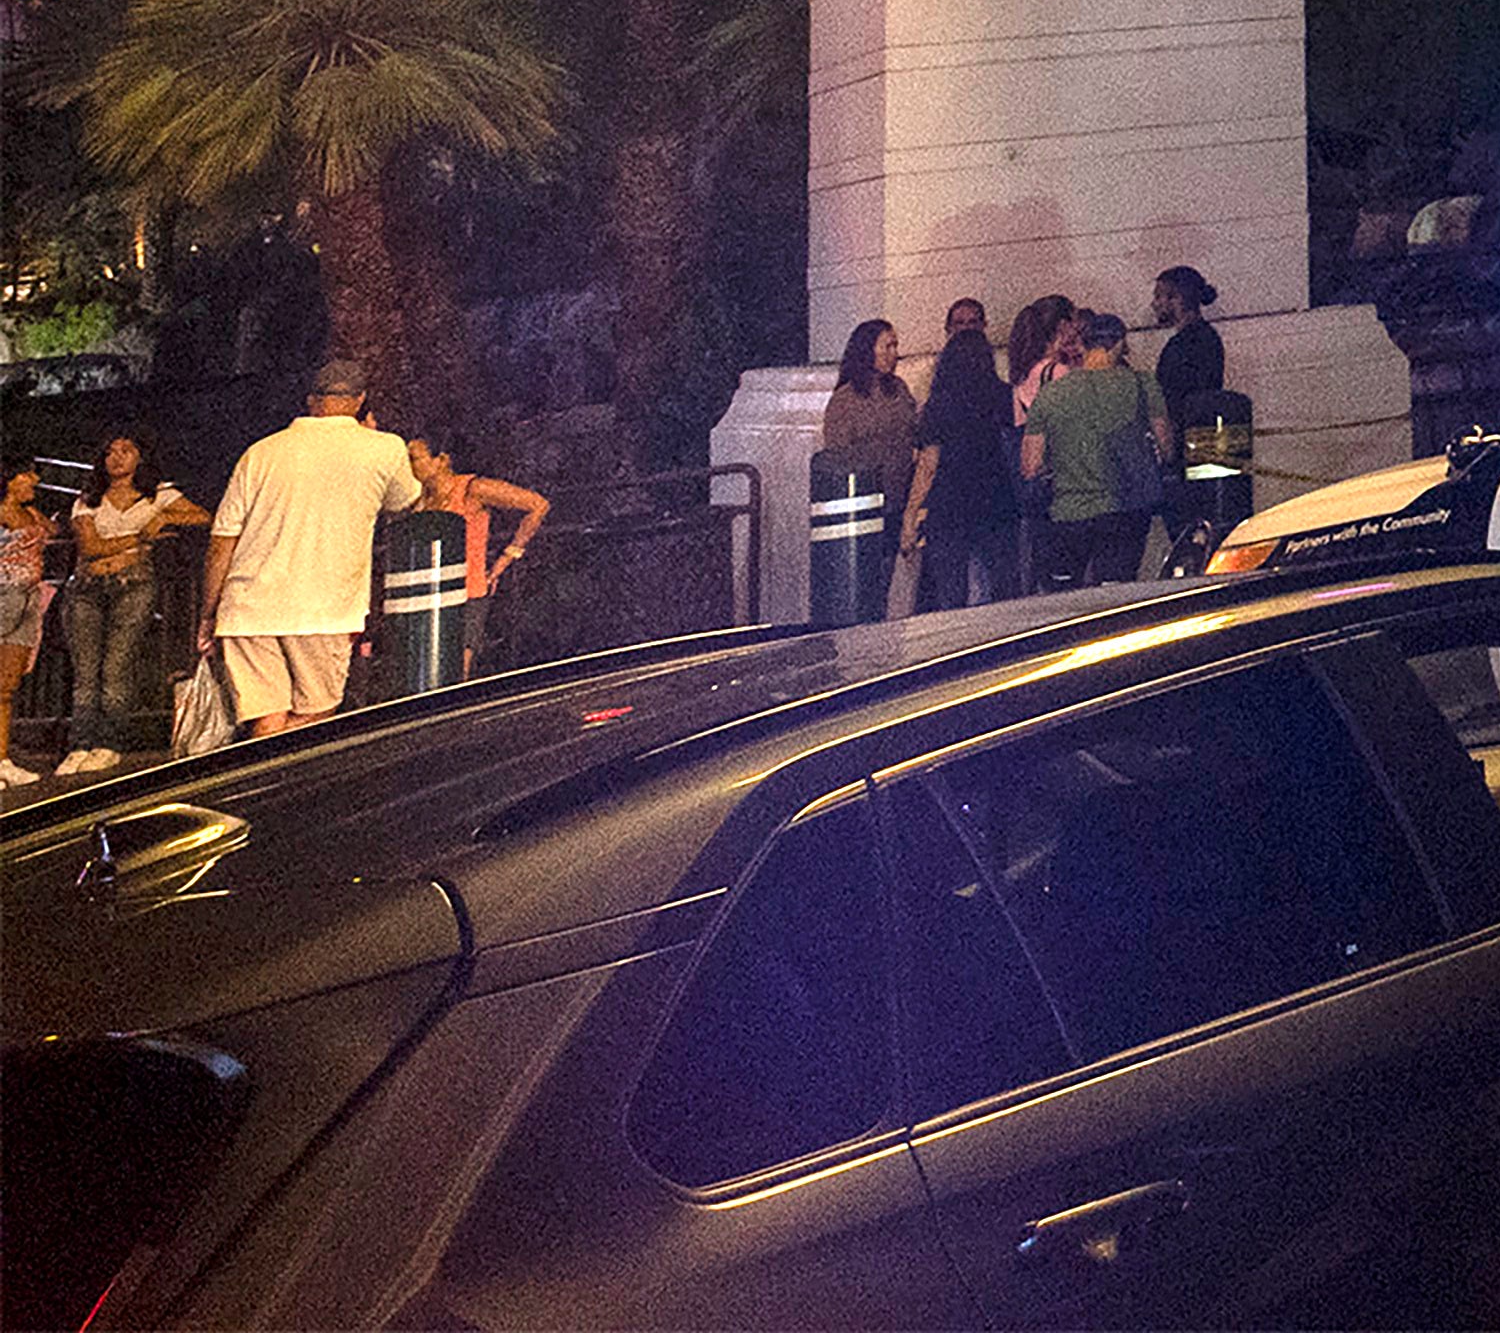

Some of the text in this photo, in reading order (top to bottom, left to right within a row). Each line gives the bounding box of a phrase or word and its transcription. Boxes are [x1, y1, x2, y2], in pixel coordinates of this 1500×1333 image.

[1333, 525, 1358, 542] with
[1359, 522, 1380, 537] the
[1382, 508, 1451, 532] Community
